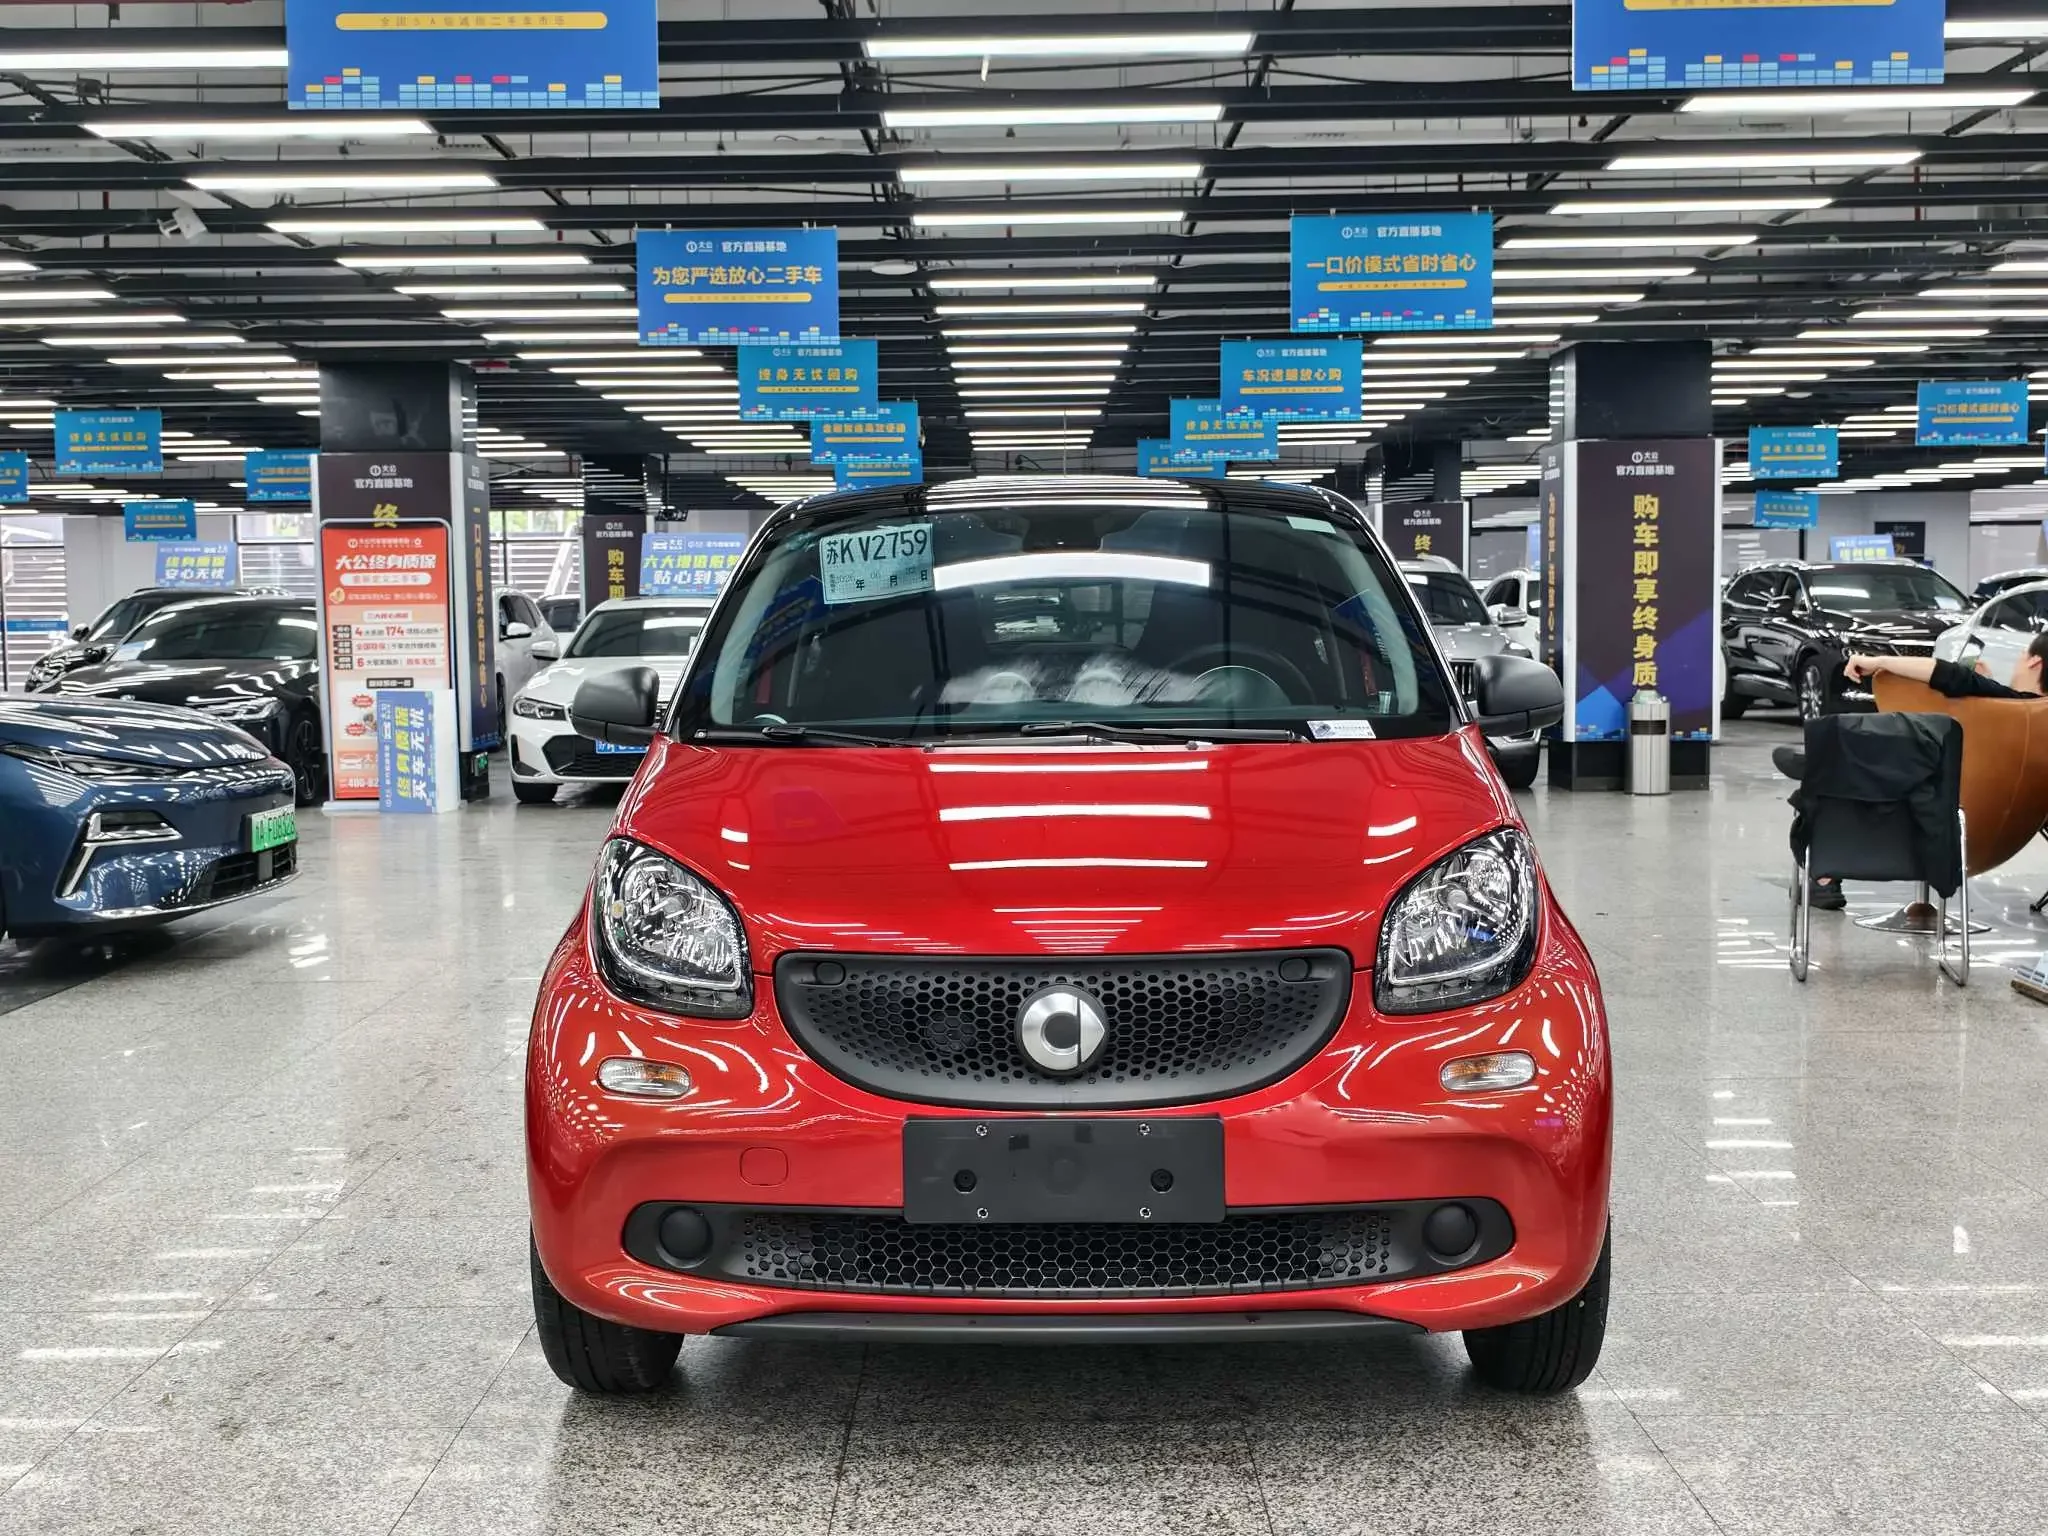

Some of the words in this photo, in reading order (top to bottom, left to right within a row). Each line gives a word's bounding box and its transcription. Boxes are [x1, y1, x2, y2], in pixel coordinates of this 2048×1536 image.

[1307, 253, 1477, 274] 一口价模式省时省心
[652, 266, 822, 286] 为您严选放心二手车
[335, 554, 437, 570] 大公终身质保
[1632, 494, 1659, 687] 购车即享终身质
[410, 707, 427, 800] 买车无忧
